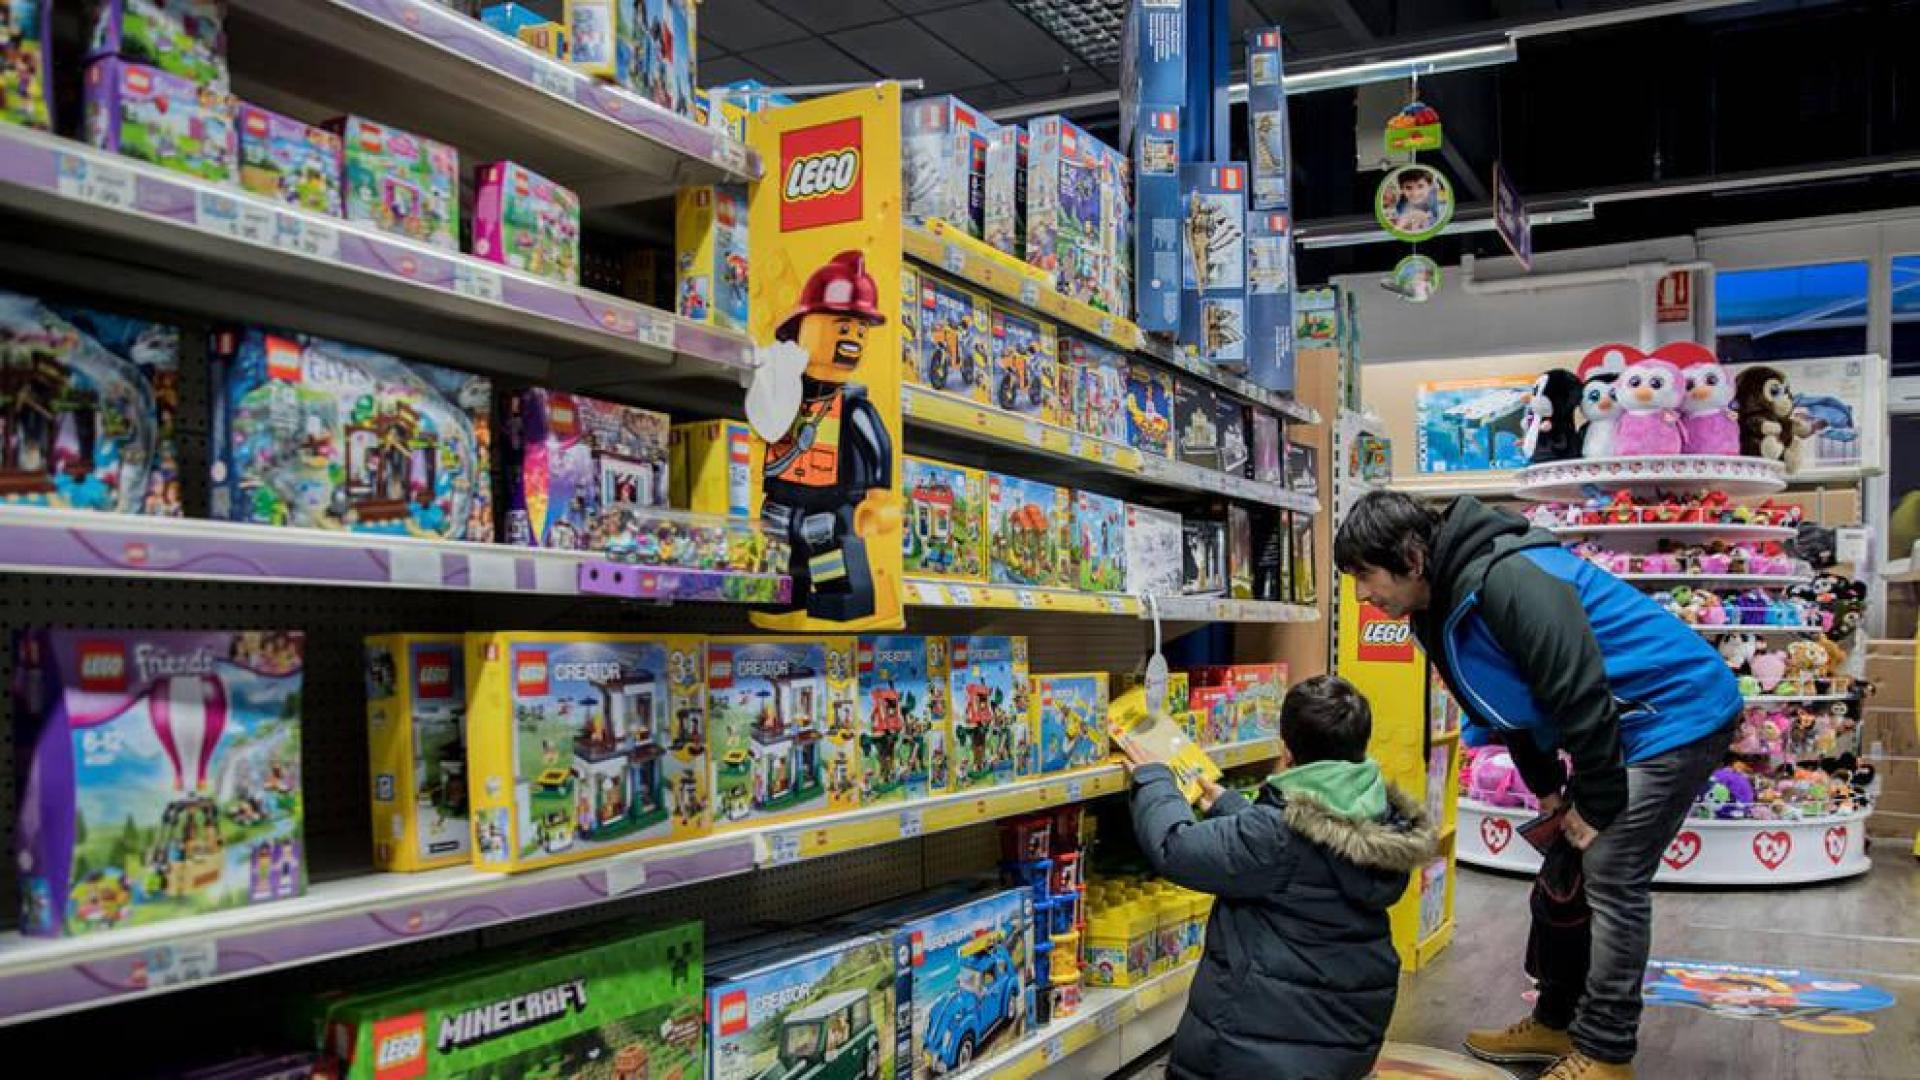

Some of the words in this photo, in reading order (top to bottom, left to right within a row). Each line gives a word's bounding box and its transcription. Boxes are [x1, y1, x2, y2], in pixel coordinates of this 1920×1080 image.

[785, 151, 857, 198] LEGO
[1363, 622, 1411, 643] LEGO
[555, 662, 621, 682] CREATOR
[1757, 833, 1789, 862] ty
[378, 1028, 424, 1068] LEGO
[436, 978, 588, 1054] MINECRAFT
